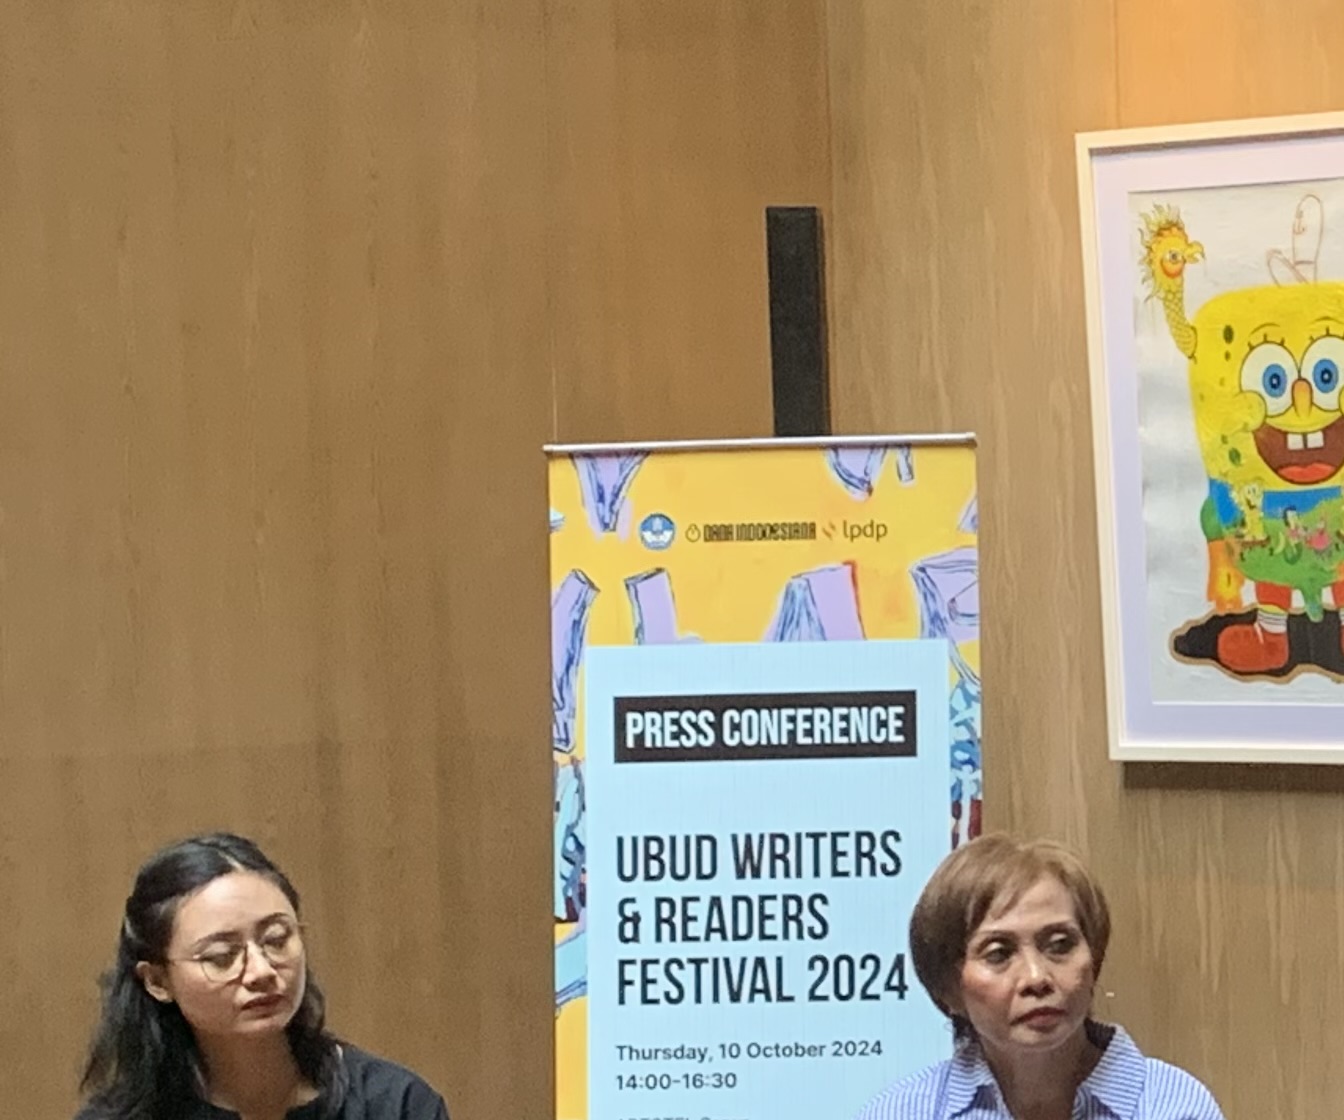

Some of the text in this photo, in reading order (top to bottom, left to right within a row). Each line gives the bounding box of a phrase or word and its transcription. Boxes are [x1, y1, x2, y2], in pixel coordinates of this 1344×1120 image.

[843, 519, 888, 542] lpdp
[625, 705, 905, 748] PRESS CONFERENCE
[616, 829, 902, 882] UBUD WRITERS
[617, 893, 829, 944] & READERS
[618, 953, 909, 1006] FESTIVAL 2024
[615, 1040, 883, 1064] Thursday, 10 October 2024
[616, 1072, 738, 1090] 14:00-16:30
